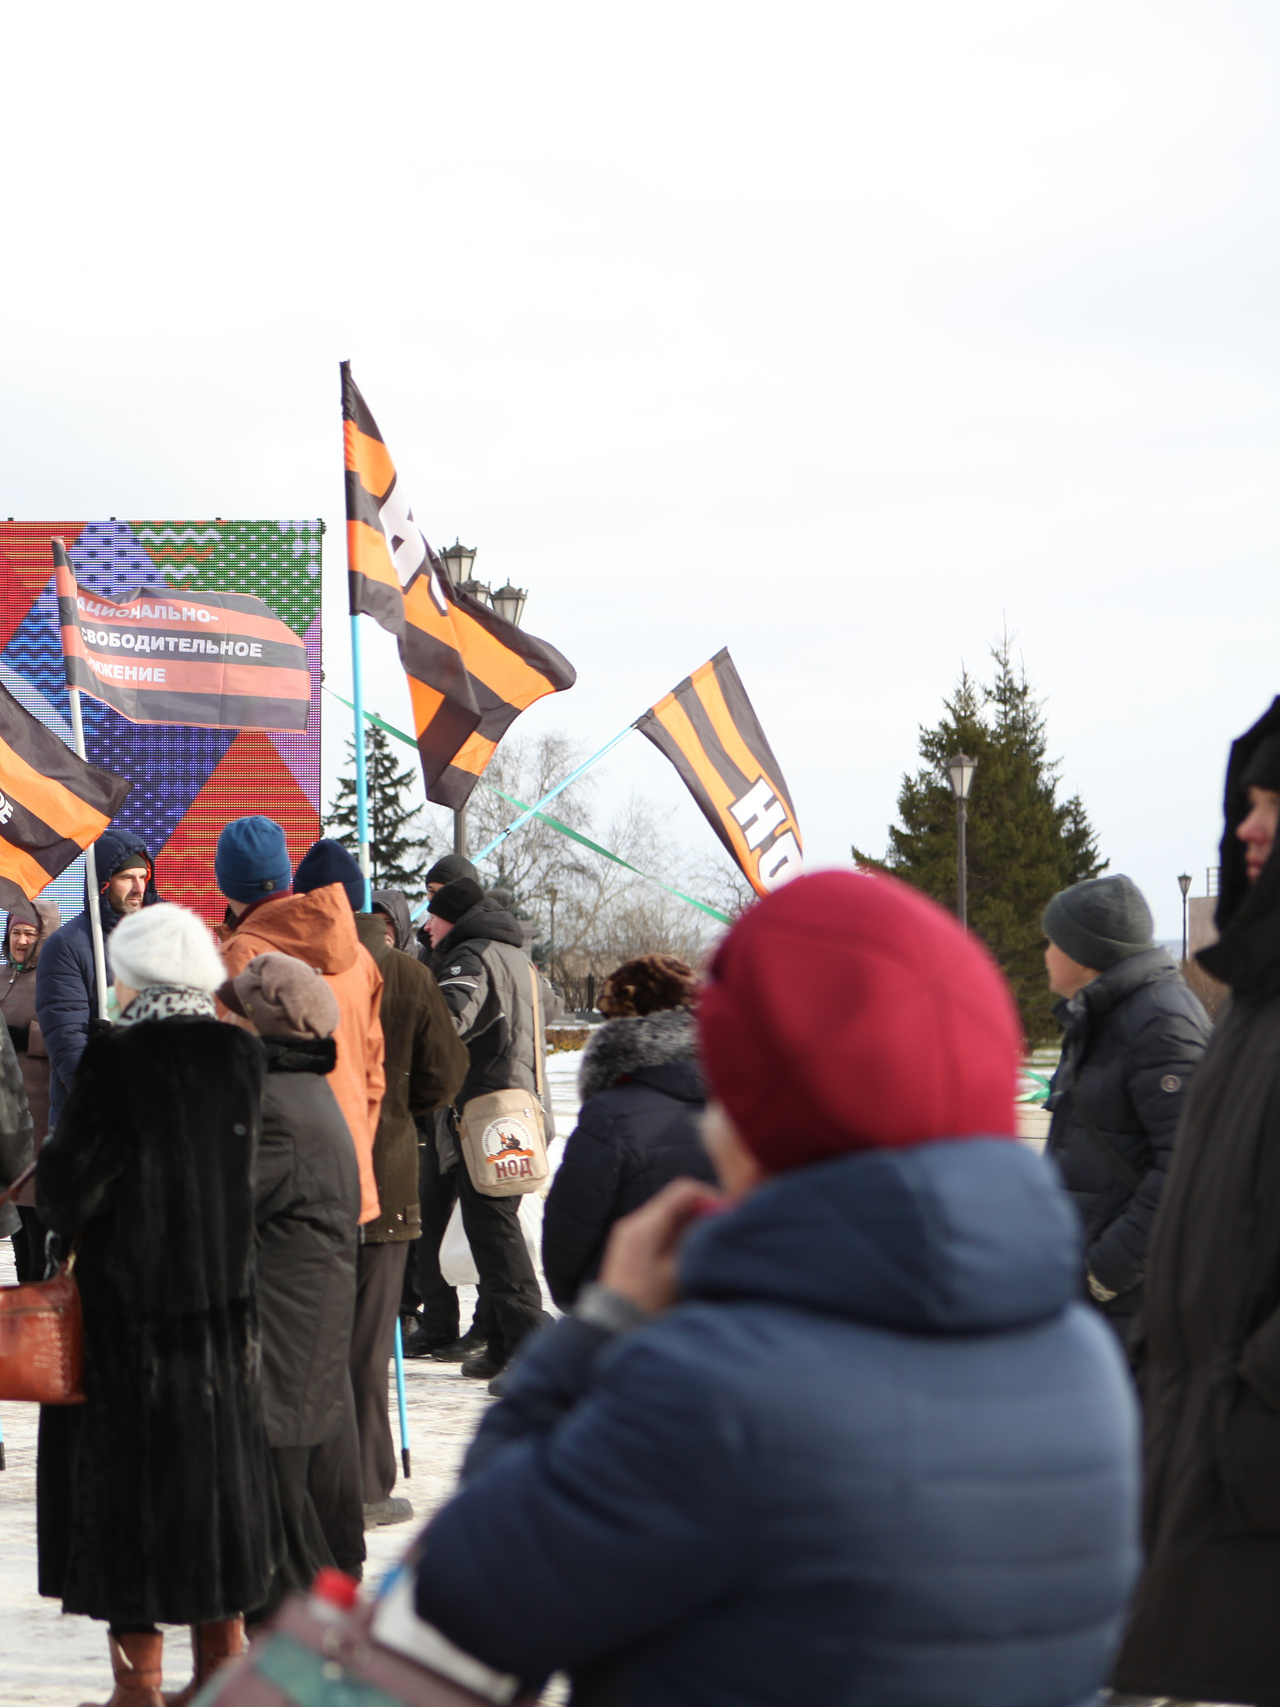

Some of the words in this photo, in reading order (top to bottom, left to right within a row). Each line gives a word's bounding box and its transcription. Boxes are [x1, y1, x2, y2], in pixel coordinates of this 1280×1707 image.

[77, 596, 219, 622] АЦИОНАЛЬНО-
[81, 627, 263, 658] СВОБОДИТЕЛЬНОЕ
[730, 777, 803, 894] НО
[495, 1158, 533, 1178] НОД
